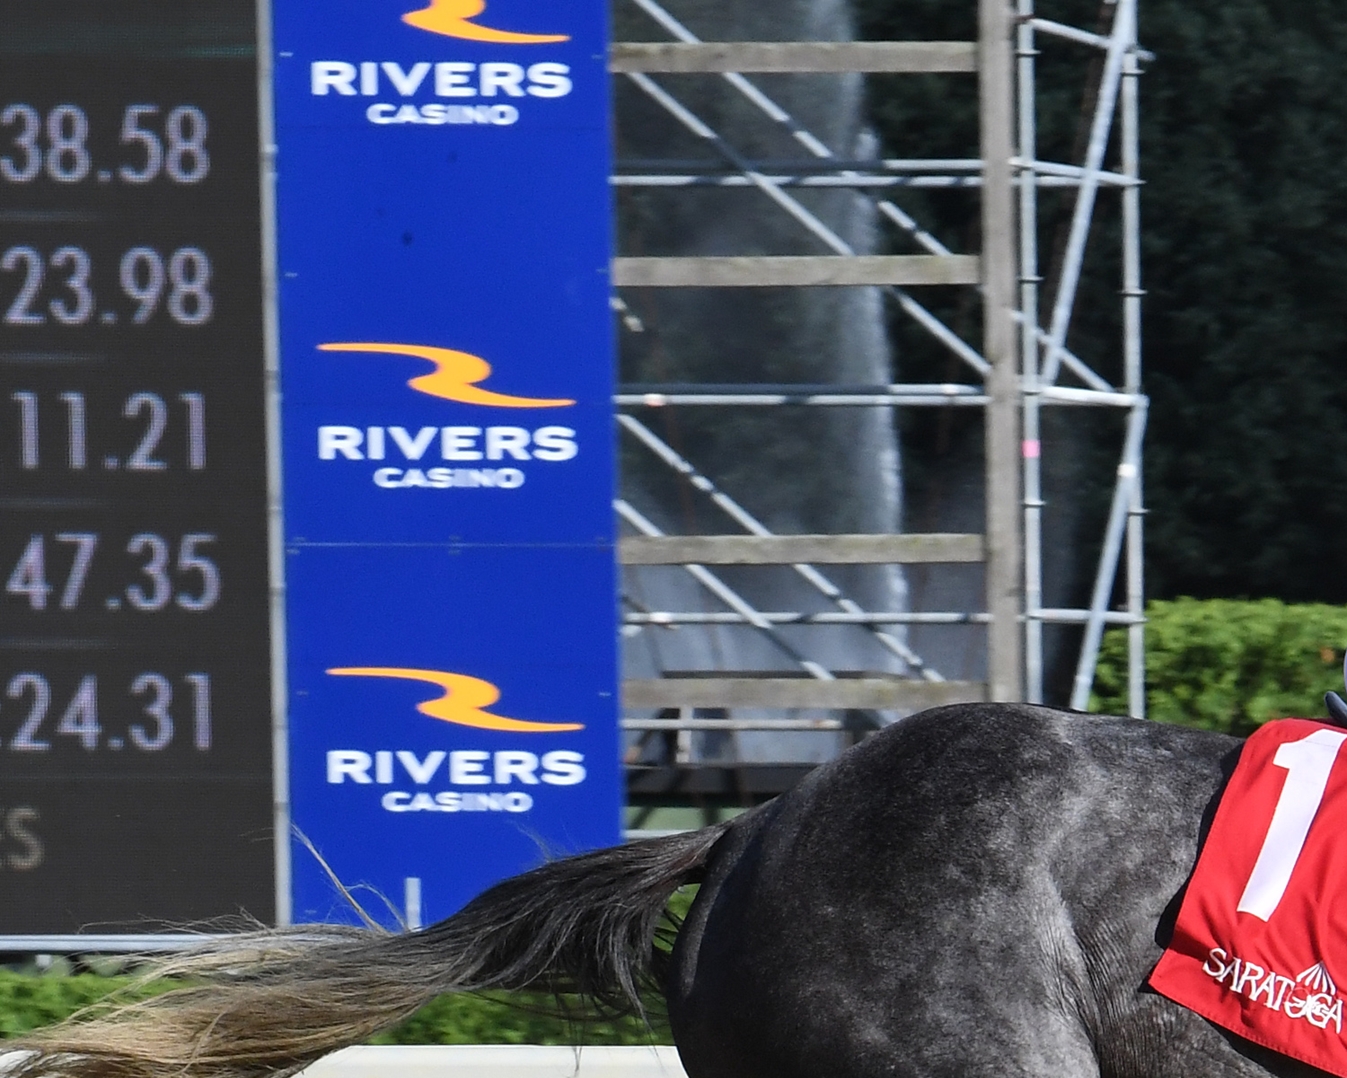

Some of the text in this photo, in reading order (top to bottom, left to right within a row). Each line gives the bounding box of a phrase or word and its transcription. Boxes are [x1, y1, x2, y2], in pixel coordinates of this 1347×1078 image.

[310, 61, 572, 98] RIVERS
[0, 103, 210, 184] 38.58
[366, 103, 519, 126] CASINO
[1, 246, 214, 326] 23.98
[11, 391, 206, 471] 11.21
[318, 425, 578, 462] RIVERS
[373, 467, 525, 489] CASINO
[6, 532, 221, 612] 47.35
[7, 672, 213, 752] 24.31
[326, 749, 586, 786] RIVERS
[382, 791, 533, 813] CASINO
[1202, 947, 1344, 1034] SARATOGA
